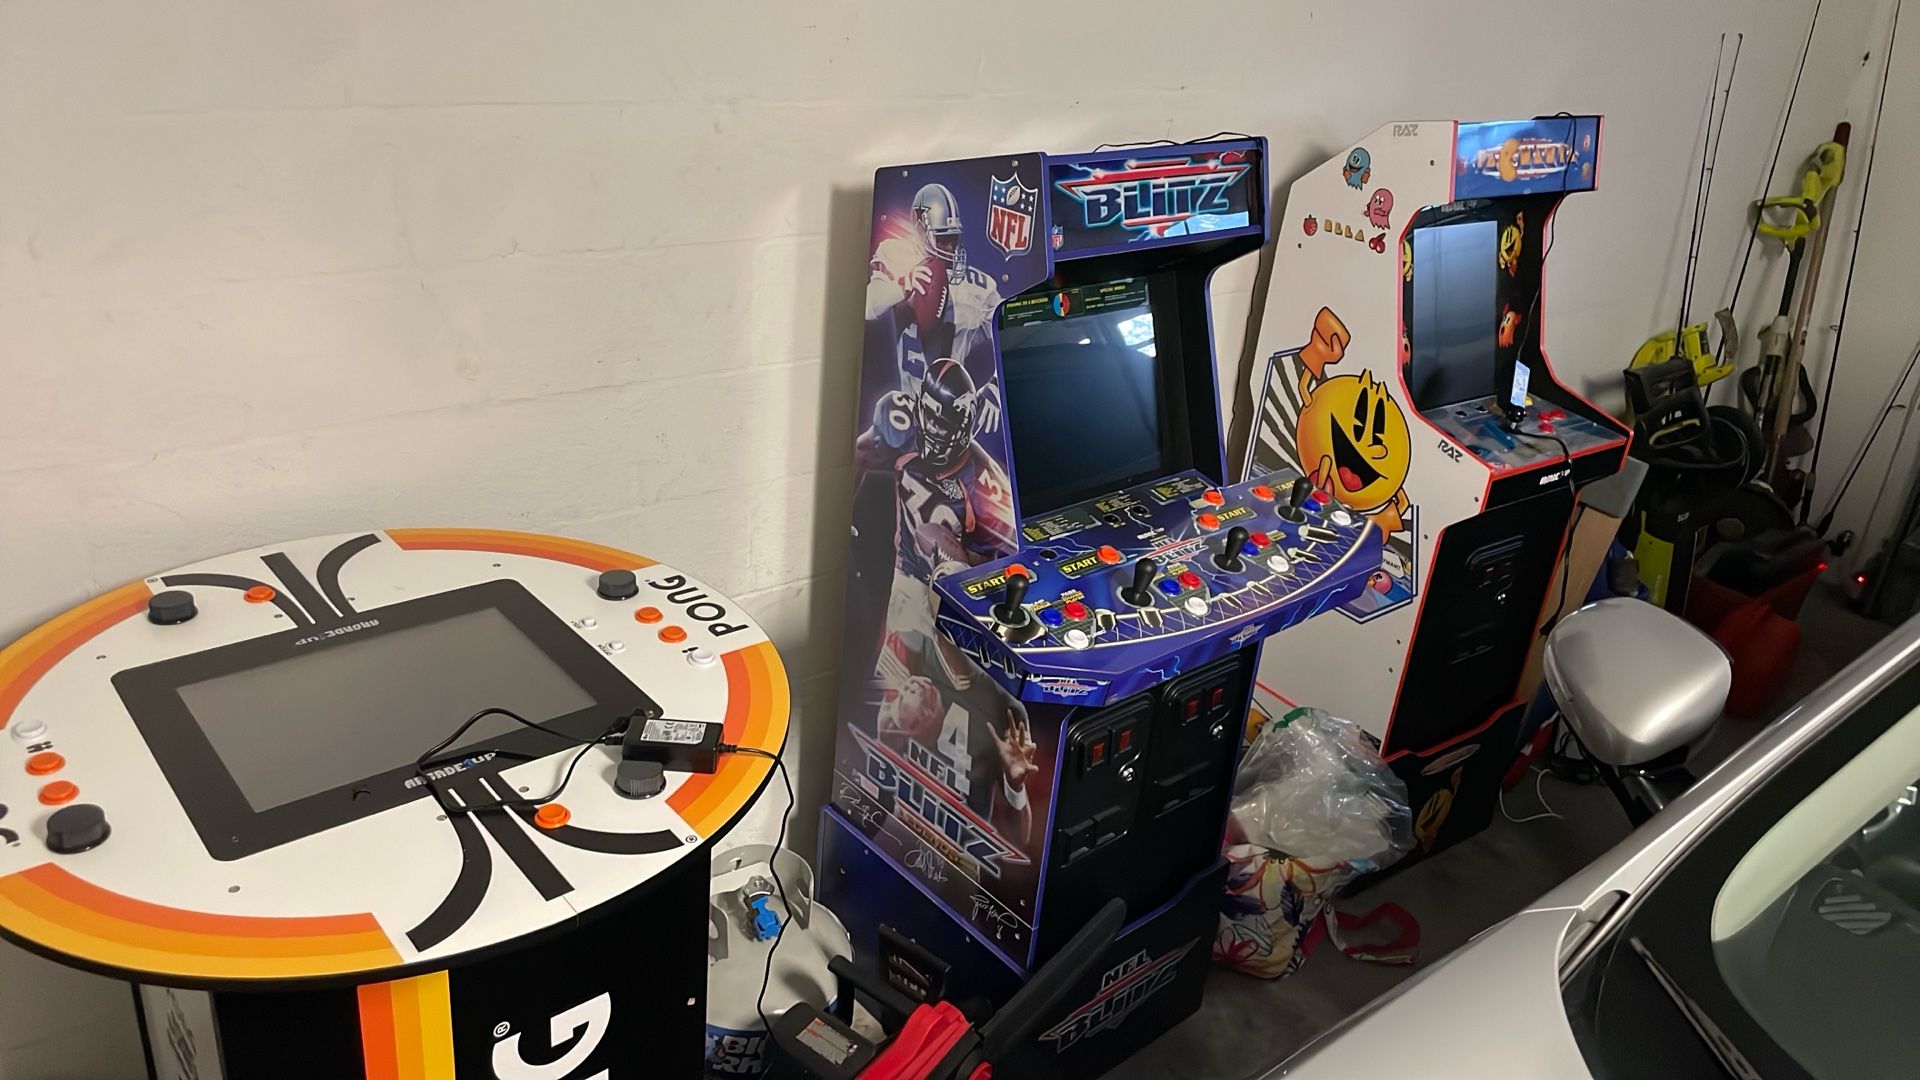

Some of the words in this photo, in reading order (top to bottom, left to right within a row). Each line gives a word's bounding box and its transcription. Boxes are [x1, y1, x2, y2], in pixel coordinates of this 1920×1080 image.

[1083, 175, 1235, 227] BLITZ
[990, 206, 1028, 249] NFL
[1216, 506, 1247, 522] START
[967, 575, 1006, 594] START
[1061, 556, 1098, 574] START
[647, 574, 750, 638] PONG
[908, 739, 968, 797] NFL
[866, 752, 1008, 879] BLITZ
[1102, 949, 1149, 990] NFL
[1056, 961, 1178, 1054] BLITZ
